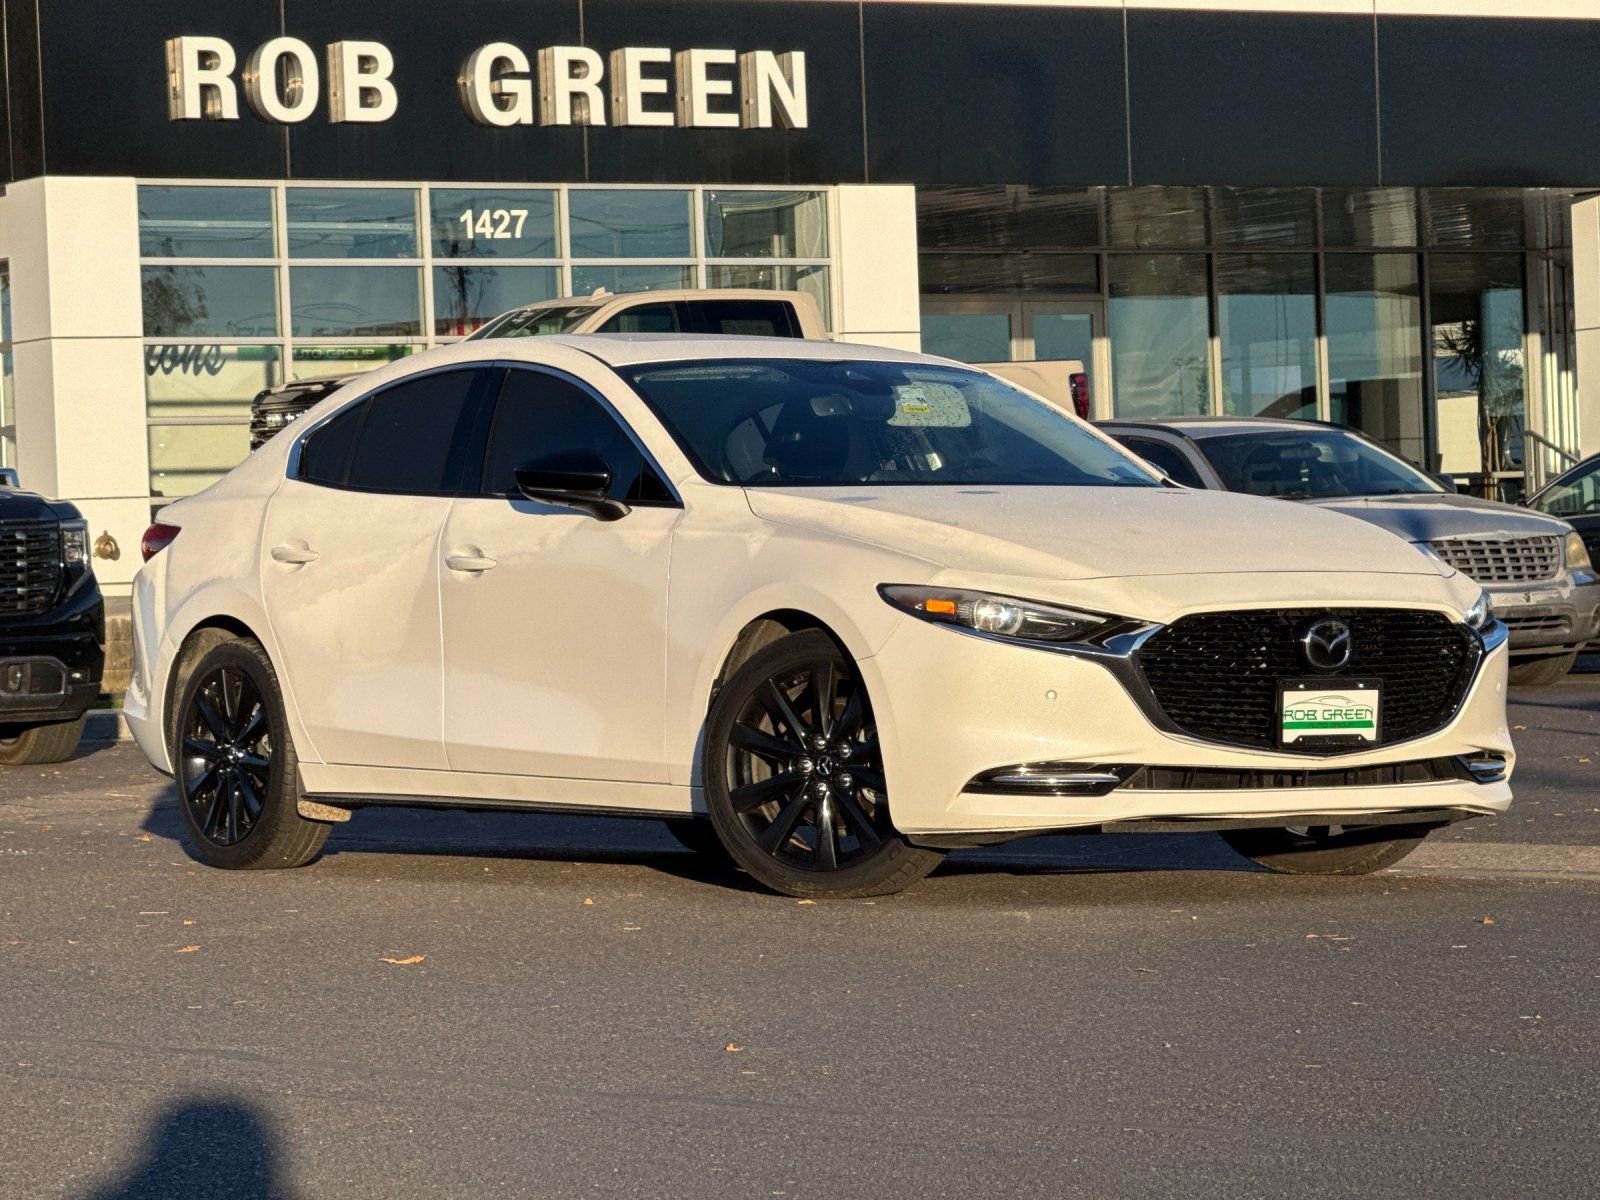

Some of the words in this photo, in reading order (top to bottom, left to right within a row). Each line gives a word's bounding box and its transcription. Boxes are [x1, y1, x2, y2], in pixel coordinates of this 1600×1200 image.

[166, 36, 398, 123] ROB
[457, 42, 808, 130] GREEN
[460, 209, 529, 239] 1427
[326, 348, 375, 359] GROUP
[1284, 709, 1318, 720] ROB
[1322, 708, 1374, 720] GREEN
